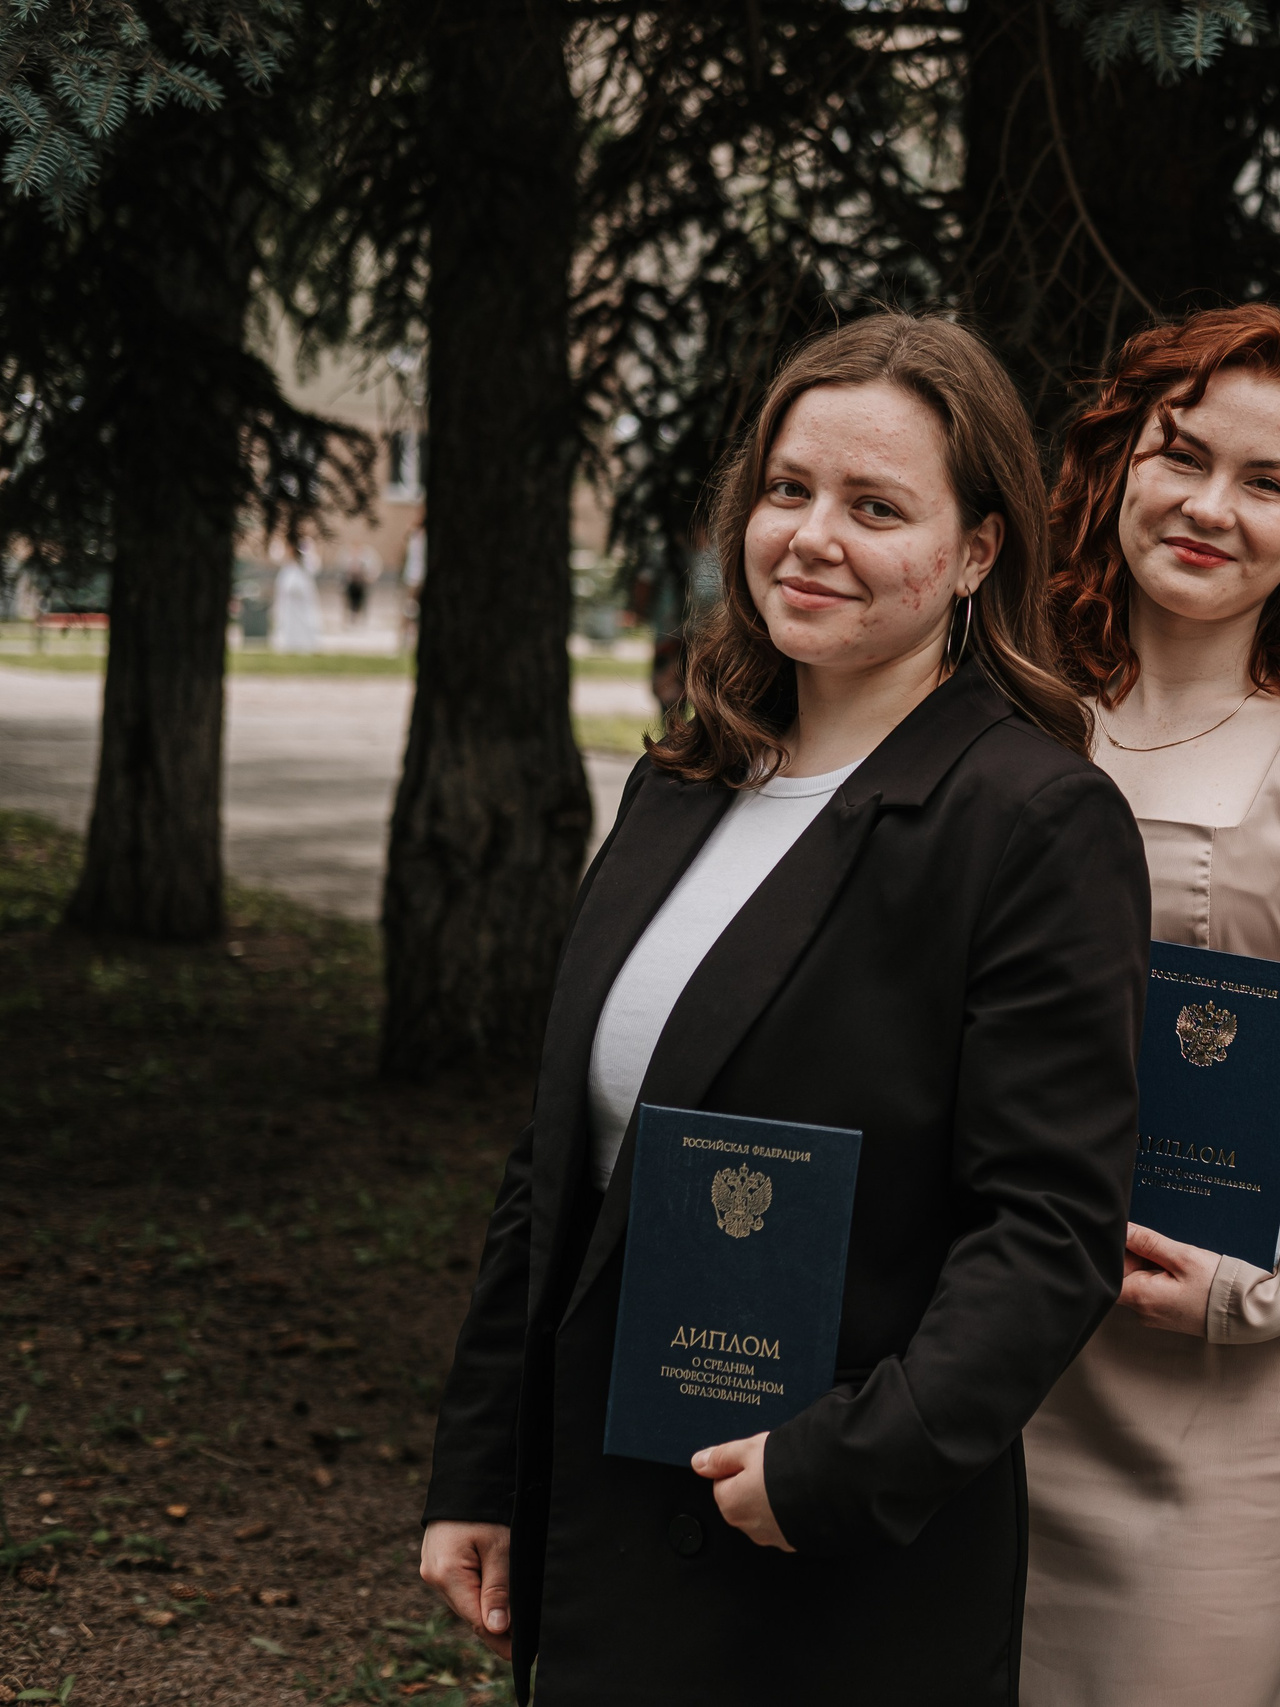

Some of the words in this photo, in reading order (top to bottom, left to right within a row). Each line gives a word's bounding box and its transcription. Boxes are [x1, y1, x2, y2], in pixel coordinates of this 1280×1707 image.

[1150, 968, 1217, 989] РОССИЙСКАЯ
[682, 1136, 749, 1155] РОССИЙСКАЯ
[752, 1145, 811, 1163] ФЕДЕРАЦИЯ
[670, 1325, 781, 1360] ДИПЛОМ
[703, 1358, 755, 1376] СРЕДНЕМ
[660, 1365, 785, 1396] ПРОФЕССИОНАЛЬНОМ
[679, 1382, 761, 1406] ОБРАЗОВАНИИ
